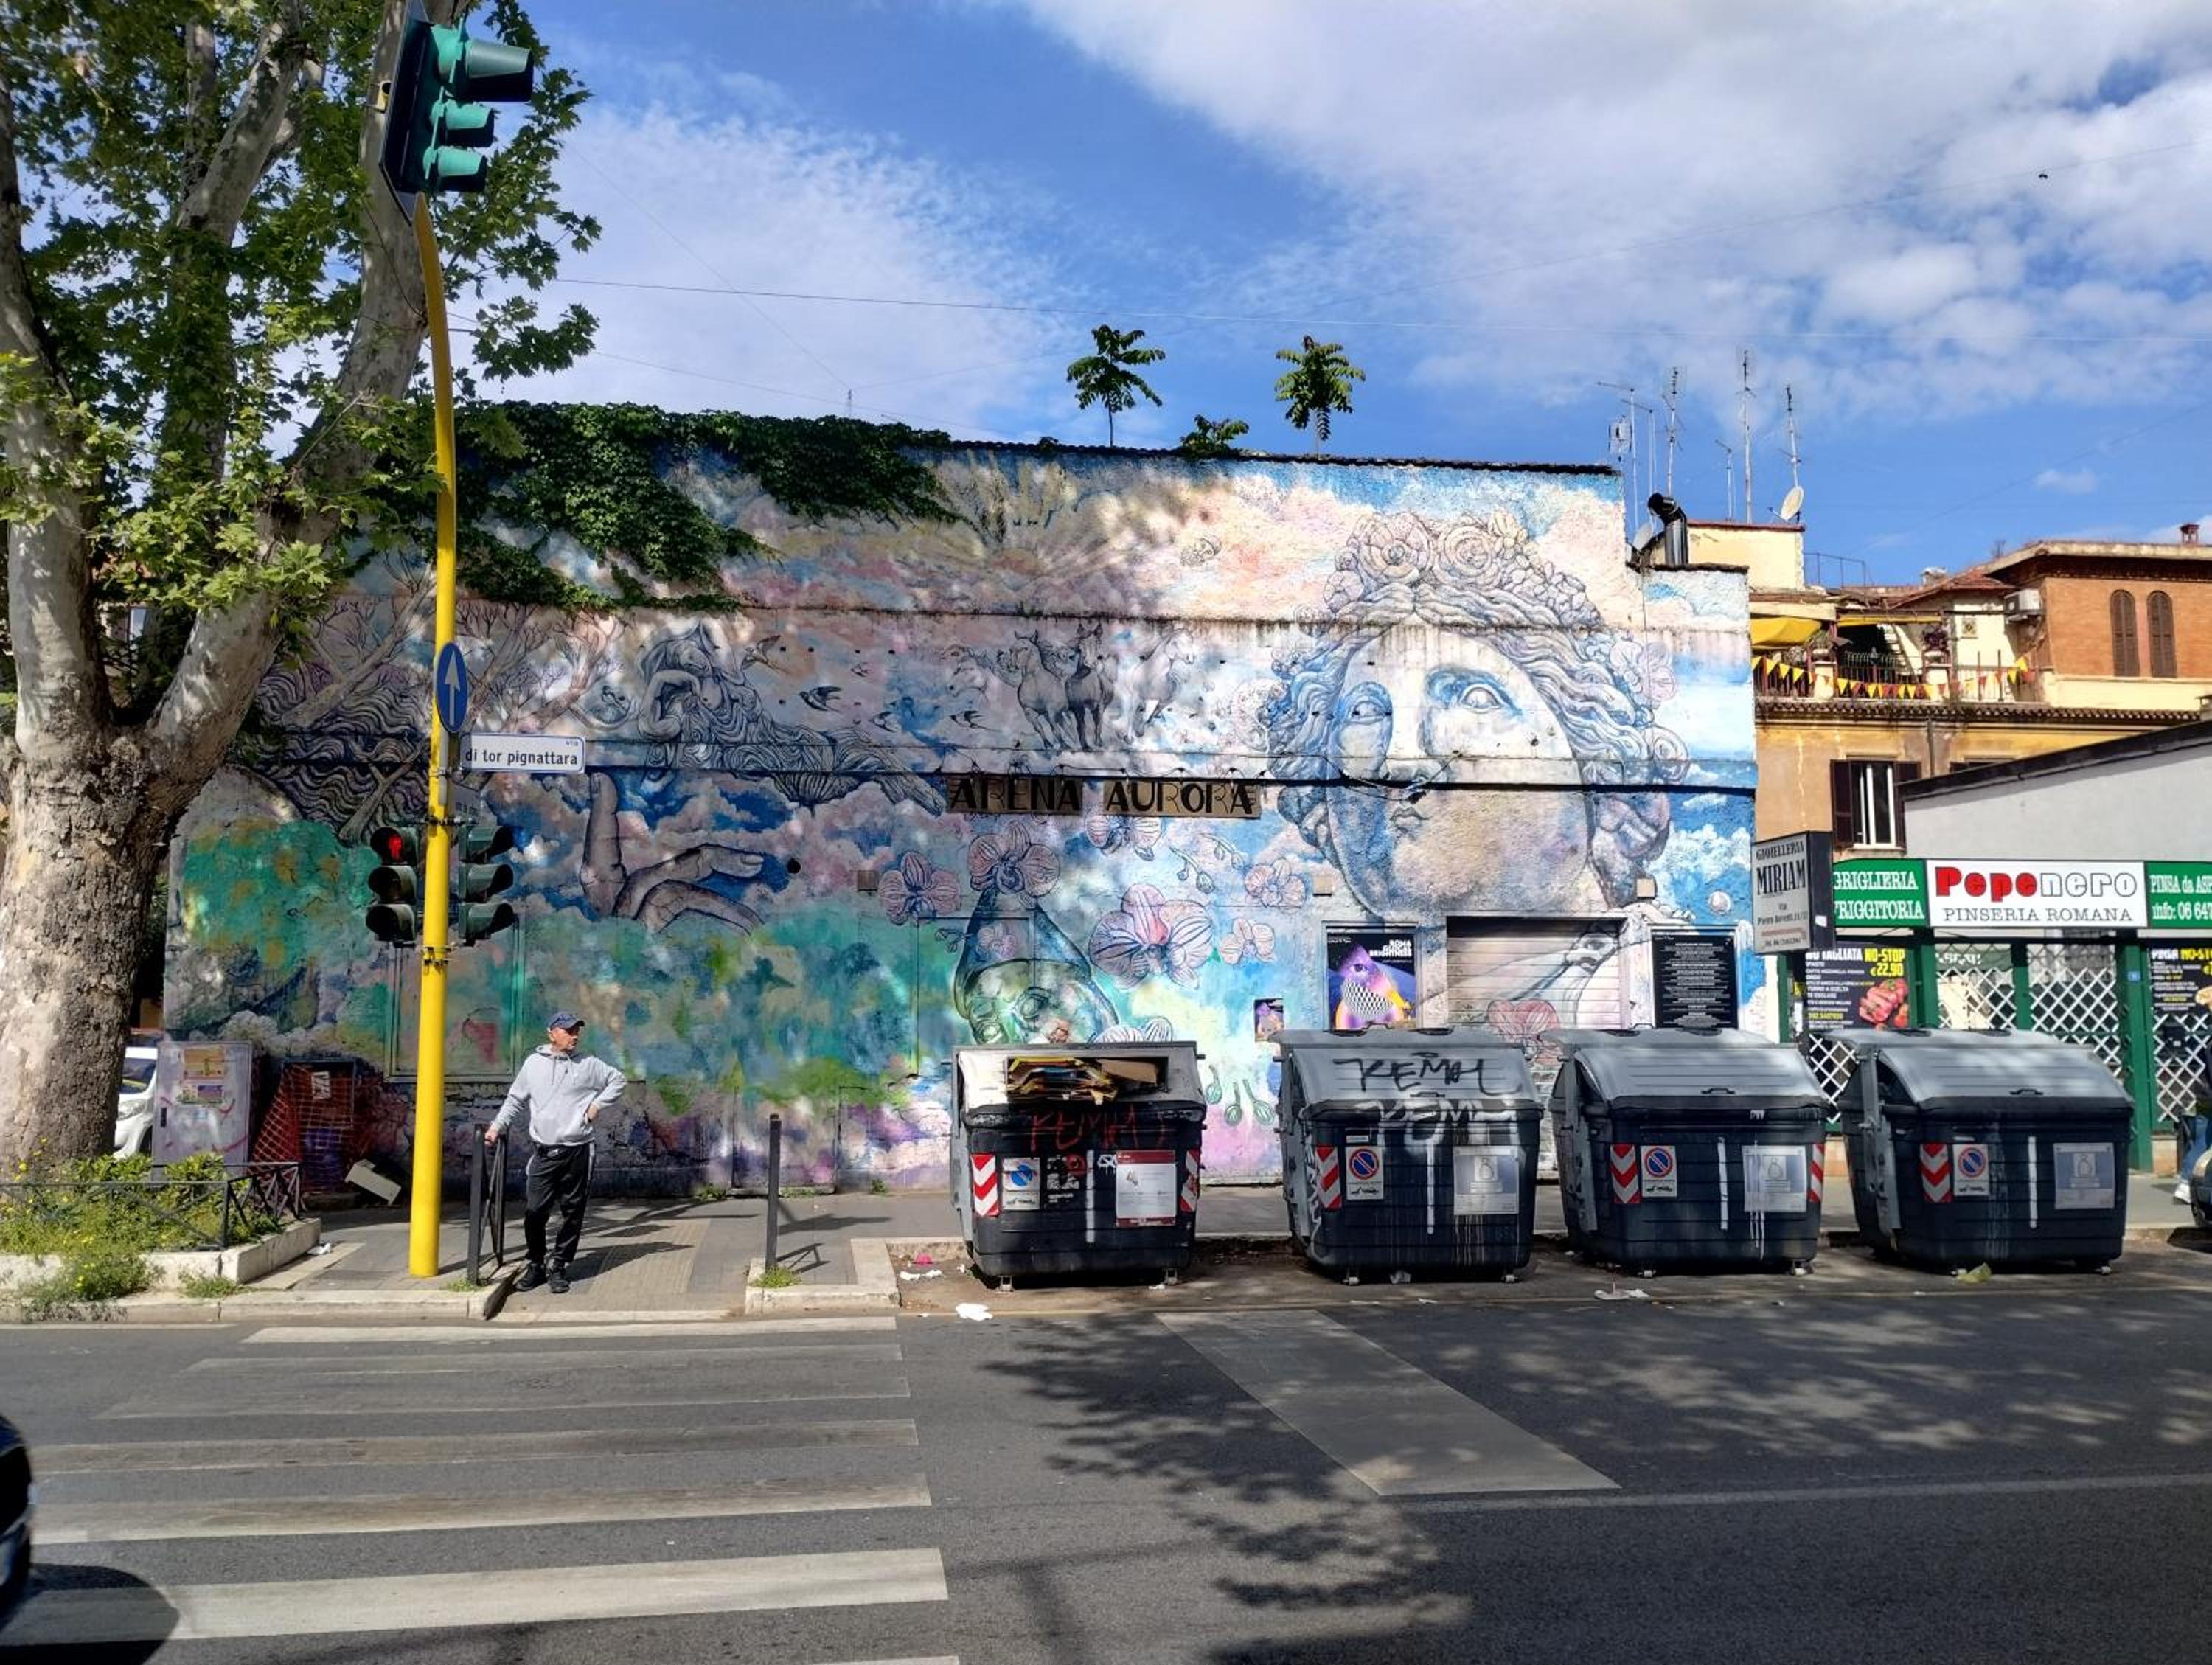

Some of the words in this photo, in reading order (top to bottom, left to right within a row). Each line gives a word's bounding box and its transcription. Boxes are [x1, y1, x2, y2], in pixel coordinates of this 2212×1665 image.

[465, 748, 478, 762] di
[483, 749, 502, 762] tor
[507, 751, 578, 766] pignattara
[949, 778, 1082, 811] ARENA
[1105, 781, 1253, 815] AURORA
[1756, 841, 1804, 861] GIOIELLERIA
[1756, 859, 1806, 896] MIRIAM
[2149, 874, 2181, 894] PINSA
[2182, 874, 2194, 894] da
[1944, 908, 2039, 922] PINSERIA
[2045, 908, 2133, 922] ROMANA
[2177, 900, 2192, 920] 06
[1863, 948, 1906, 962] NO-STOP
